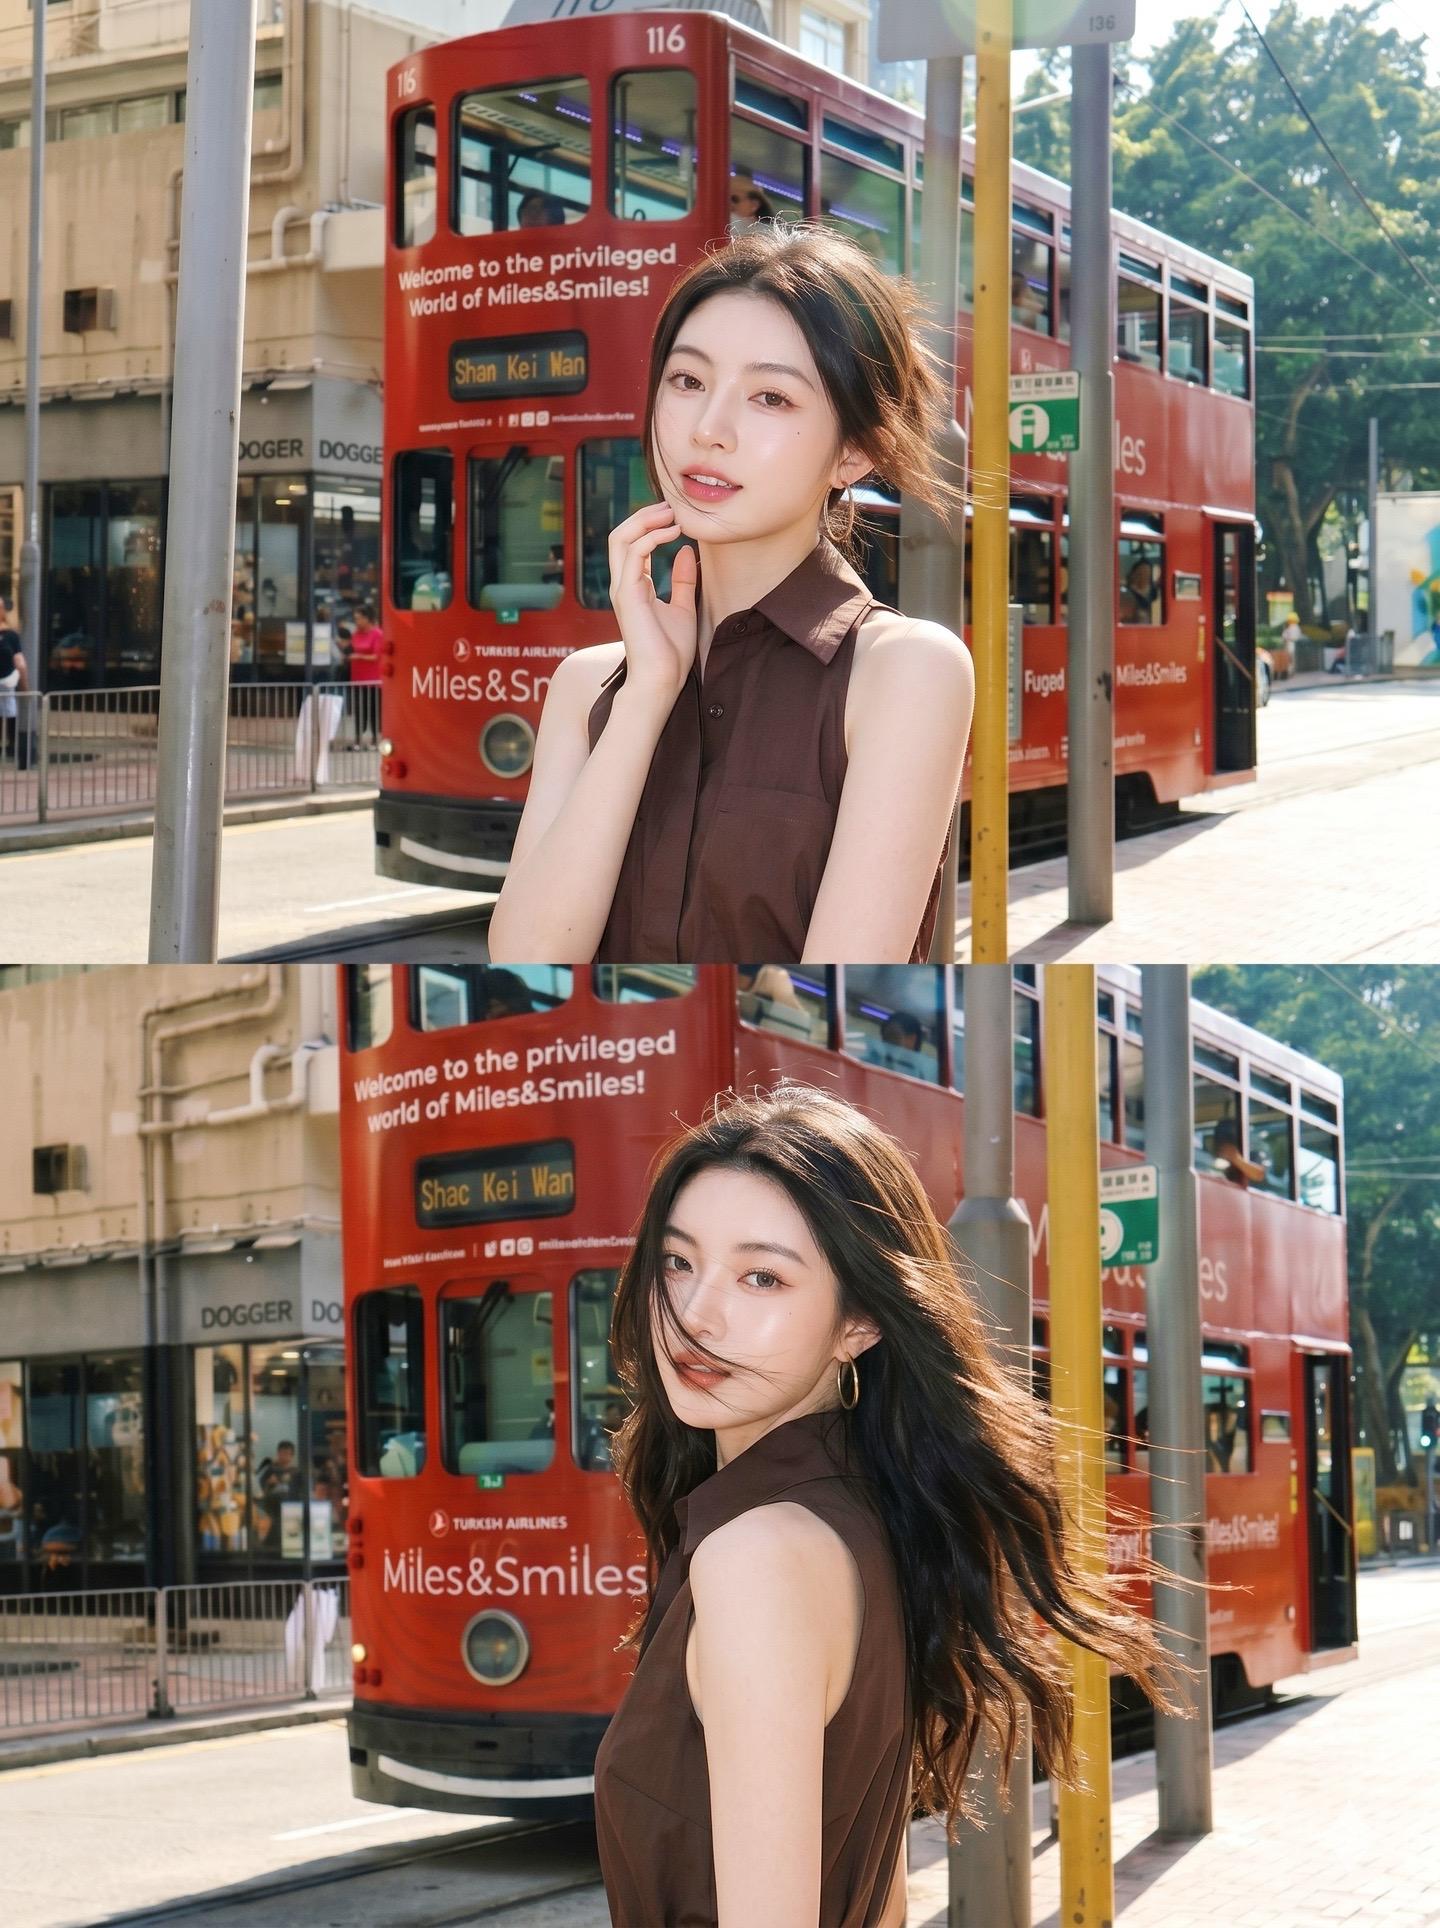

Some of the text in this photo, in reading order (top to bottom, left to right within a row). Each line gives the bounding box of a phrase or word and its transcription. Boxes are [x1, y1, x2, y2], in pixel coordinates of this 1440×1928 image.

[646, 24, 686, 54] 116
[1089, 15, 1116, 32] 136
[399, 243, 677, 291] Welcome to the privileged
[409, 275, 650, 317] World of Miles&Smiles!
[455, 351, 585, 385] Shan Kei Wan
[354, 1029, 676, 1102] Welcome to the privileged
[425, 1094, 449, 1120] of
[455, 1070, 645, 1114] Miles&Smiles!
[483, 1171, 518, 1203] Kei
[531, 1166, 574, 1198] Wan
[201, 1300, 293, 1329] DOGGER
[506, 1516, 568, 1530] AIRLINES
[383, 1543, 647, 1596] Miles&Smiles
